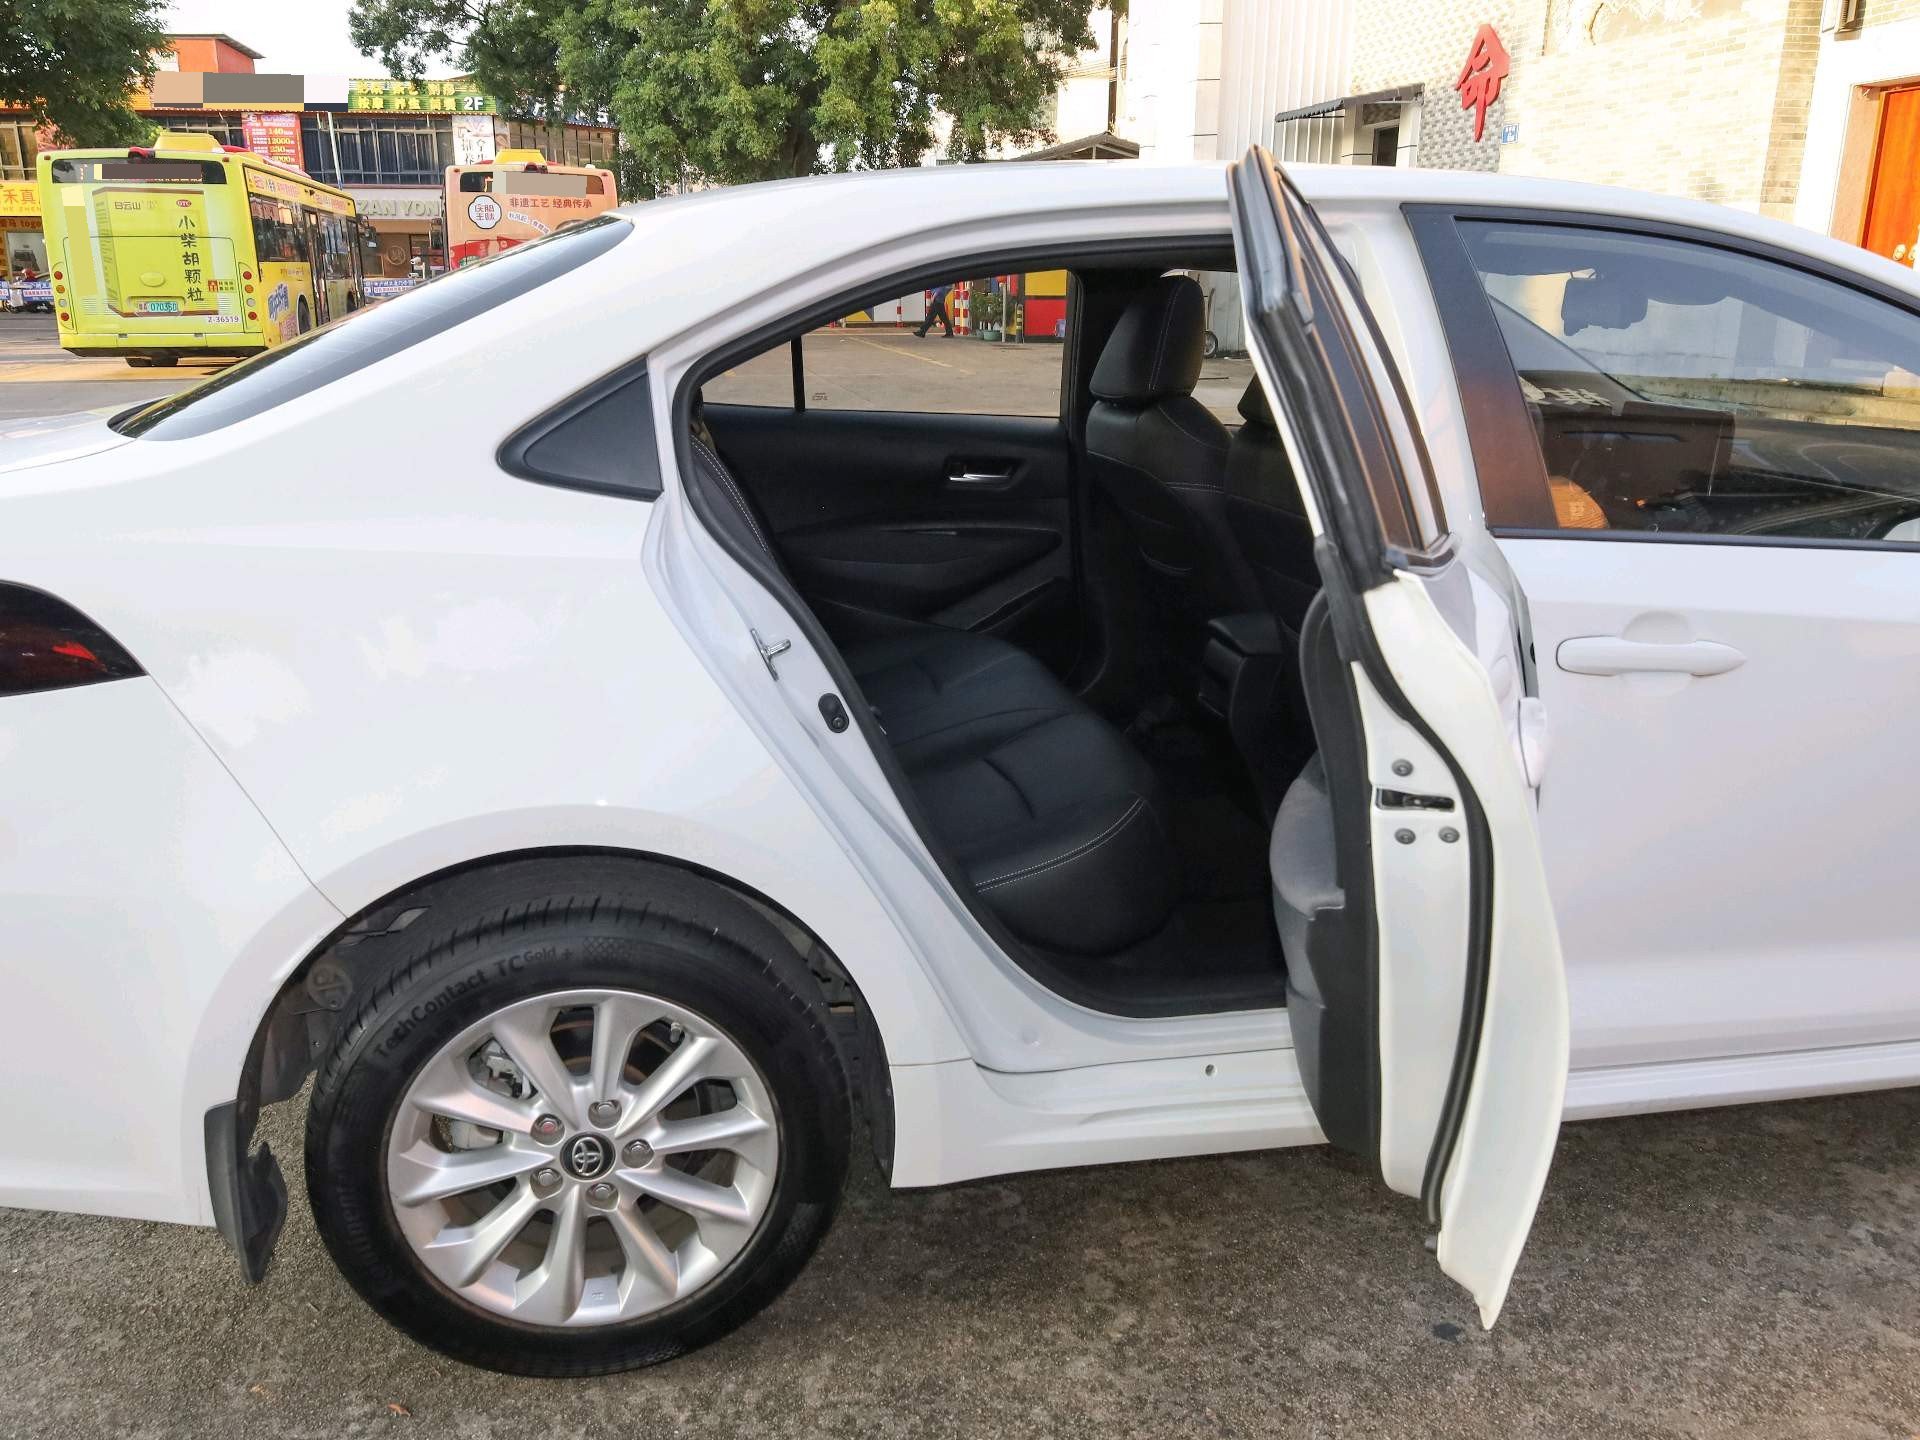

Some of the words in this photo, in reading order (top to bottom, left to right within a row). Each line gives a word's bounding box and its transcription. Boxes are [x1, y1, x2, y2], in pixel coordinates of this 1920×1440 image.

[463, 97, 483, 110] 2F
[1455, 24, 1509, 142] 命
[510, 197, 549, 208] 非遗工艺
[552, 198, 592, 209] 经典传承
[178, 215, 204, 302] 小柴胡颗粒
[374, 968, 489, 1056] TechContact
[494, 955, 525, 976] TC
[524, 948, 556, 963] Gold
